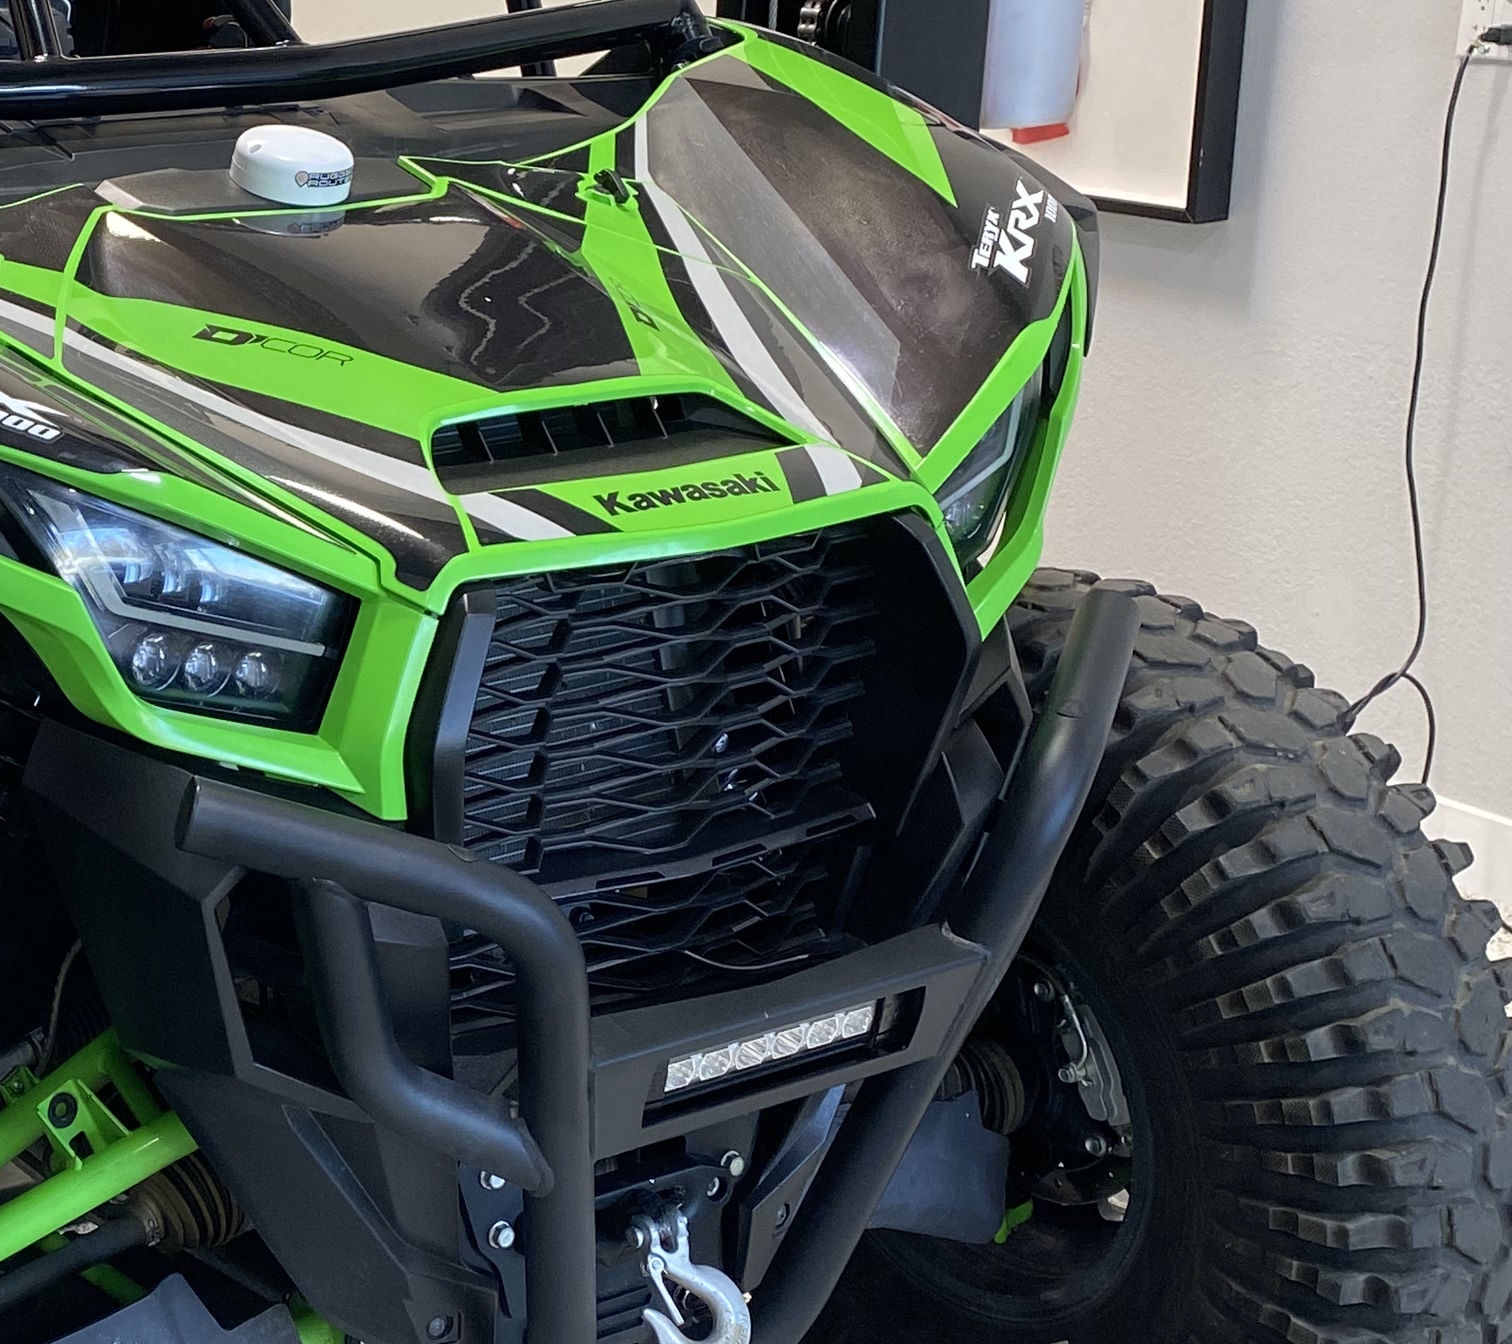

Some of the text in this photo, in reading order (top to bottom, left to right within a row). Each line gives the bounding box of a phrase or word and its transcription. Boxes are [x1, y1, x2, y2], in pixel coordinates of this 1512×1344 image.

[970, 206, 1001, 270] TERYX
[993, 179, 1044, 284] KRX
[592, 471, 781, 518] Kawasaki
